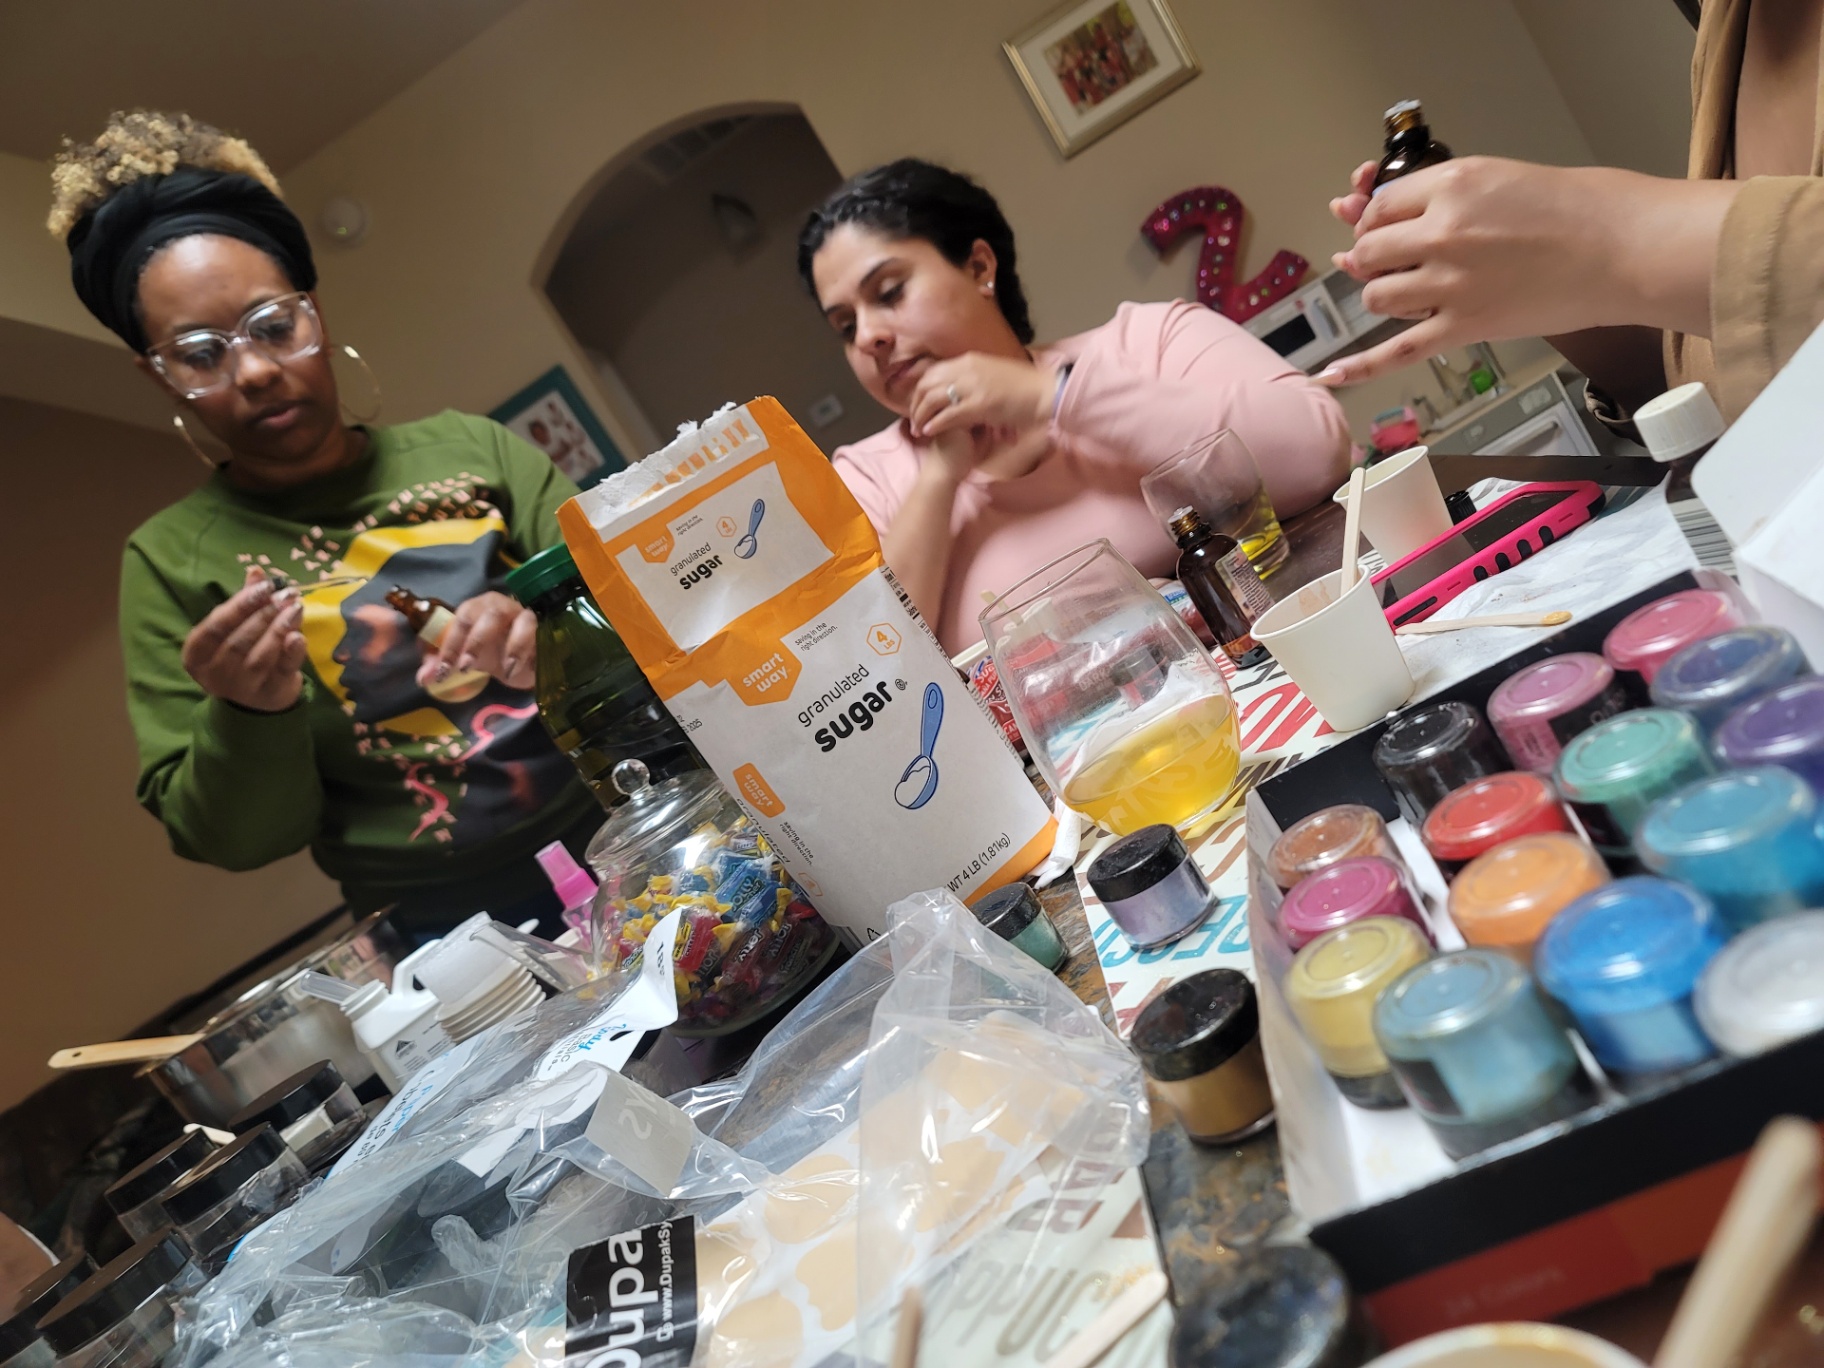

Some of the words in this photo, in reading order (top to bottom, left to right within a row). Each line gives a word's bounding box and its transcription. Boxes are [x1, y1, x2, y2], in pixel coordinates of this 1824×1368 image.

[722, 520, 729, 529] 4
[644, 535, 669, 553] smart
[651, 543, 669, 557] way
[670, 541, 712, 577] granulated
[679, 554, 723, 590] sugar
[794, 628, 813, 647] saving
[815, 621, 828, 634] the
[800, 637, 815, 652] right
[876, 630, 889, 643] 4
[883, 640, 896, 651] LBS
[742, 652, 784, 688] smart
[755, 665, 789, 693] way
[798, 663, 870, 728] granulated
[814, 681, 893, 753] sugar
[743, 782, 765, 807] way
[744, 773, 773, 808] smart
[779, 823, 793, 840] right
[784, 821, 801, 842] saving
[804, 847, 814, 860] the
[946, 874, 964, 893] WT
[962, 869, 971, 881] 4
[967, 859, 982, 876] LB
[977, 831, 1011, 867] (1.81kg)
[731, 876, 755, 913] JOLLY
